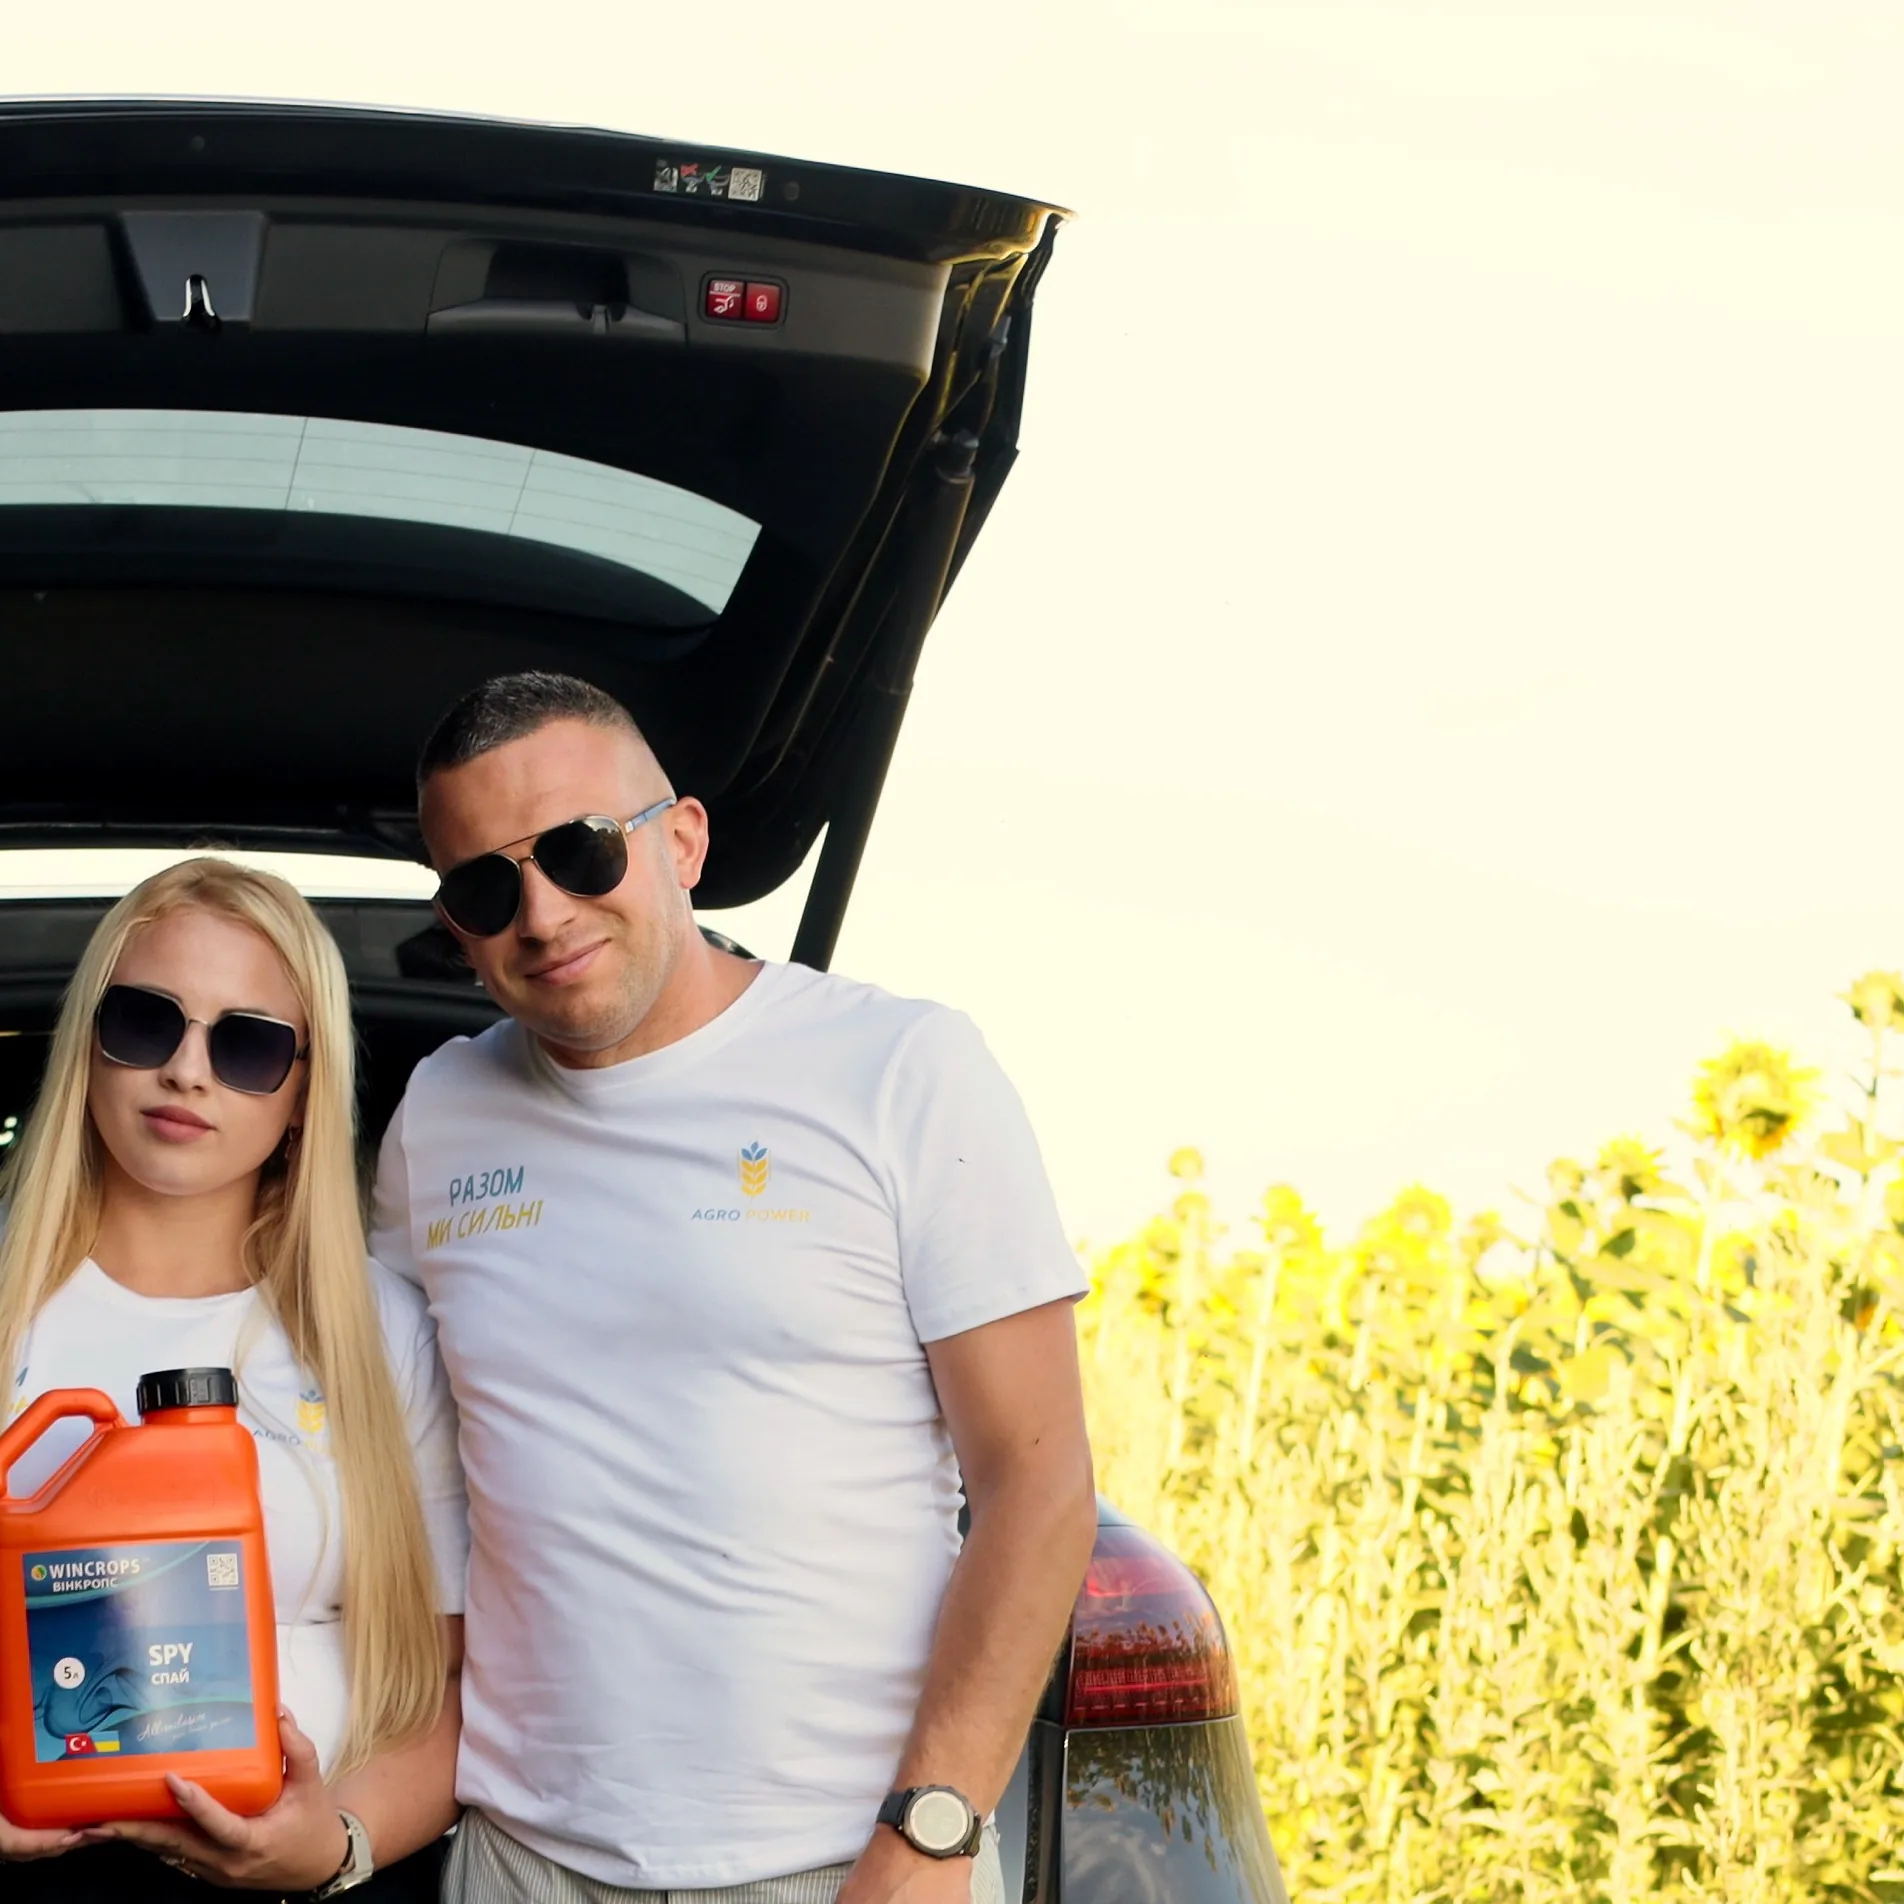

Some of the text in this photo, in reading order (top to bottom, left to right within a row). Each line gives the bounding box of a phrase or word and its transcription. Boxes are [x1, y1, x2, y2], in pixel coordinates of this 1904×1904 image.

[713, 282, 736, 293] STOP
[449, 1165, 525, 1207] РАЗОМ
[690, 1208, 811, 1222] AGRO POWER
[49, 1558, 141, 1580] WINCROPS
[53, 1577, 118, 1593] ВІНКРОПС
[148, 1642, 194, 1667] SPY
[151, 1667, 190, 1686] СПАЙ
